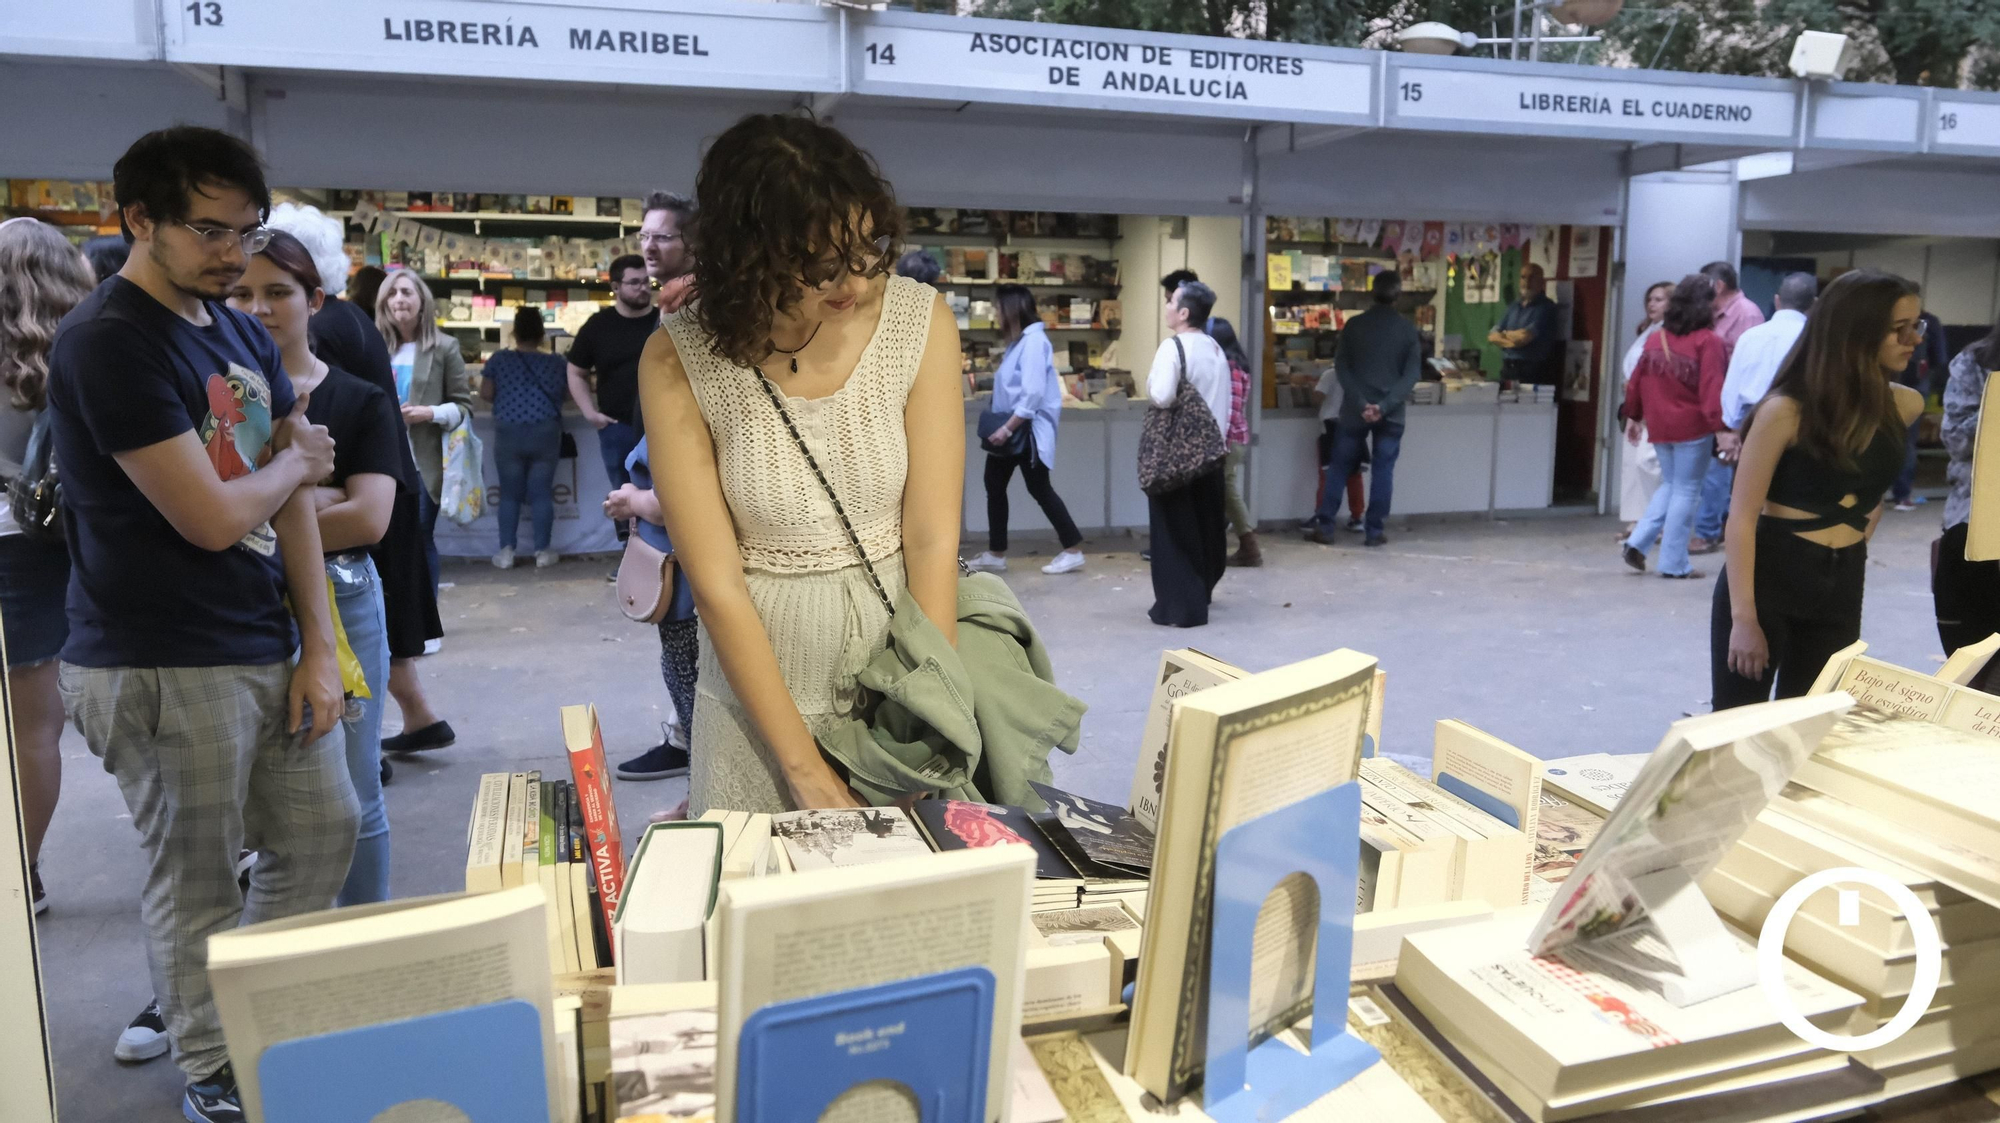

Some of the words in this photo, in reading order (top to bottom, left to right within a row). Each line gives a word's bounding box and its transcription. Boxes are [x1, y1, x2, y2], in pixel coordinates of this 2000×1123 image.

[187, 1, 223, 26] 13
[385, 17, 539, 49] LIBRERÍA
[569, 28, 709, 57] MARIBEL
[866, 43, 896, 65] 14
[1141, 45, 1172, 66] DE
[1190, 48, 1304, 76] EDITORES
[1049, 66, 1080, 86] DE
[1102, 70, 1248, 100] ANDALUCÍA
[1400, 83, 1422, 101] 15
[1520, 92, 1612, 114] LIBRERÍA
[1622, 99, 1645, 117] EL
[1652, 101, 1752, 122] CUADERNO
[1940, 113, 1957, 130] 16
[1854, 669, 1883, 689] Bajo
[1885, 680, 1900, 692] el
[1899, 685, 1934, 704] signo
[1845, 685, 1860, 697] de
[1860, 689, 1874, 702] la
[1875, 699, 1929, 720] esvástica
[1974, 706, 1992, 720] La
[1971, 721, 1986, 733] de
[1139, 796, 1158, 817] IBN
[596, 844, 619, 903] ACTIVA
